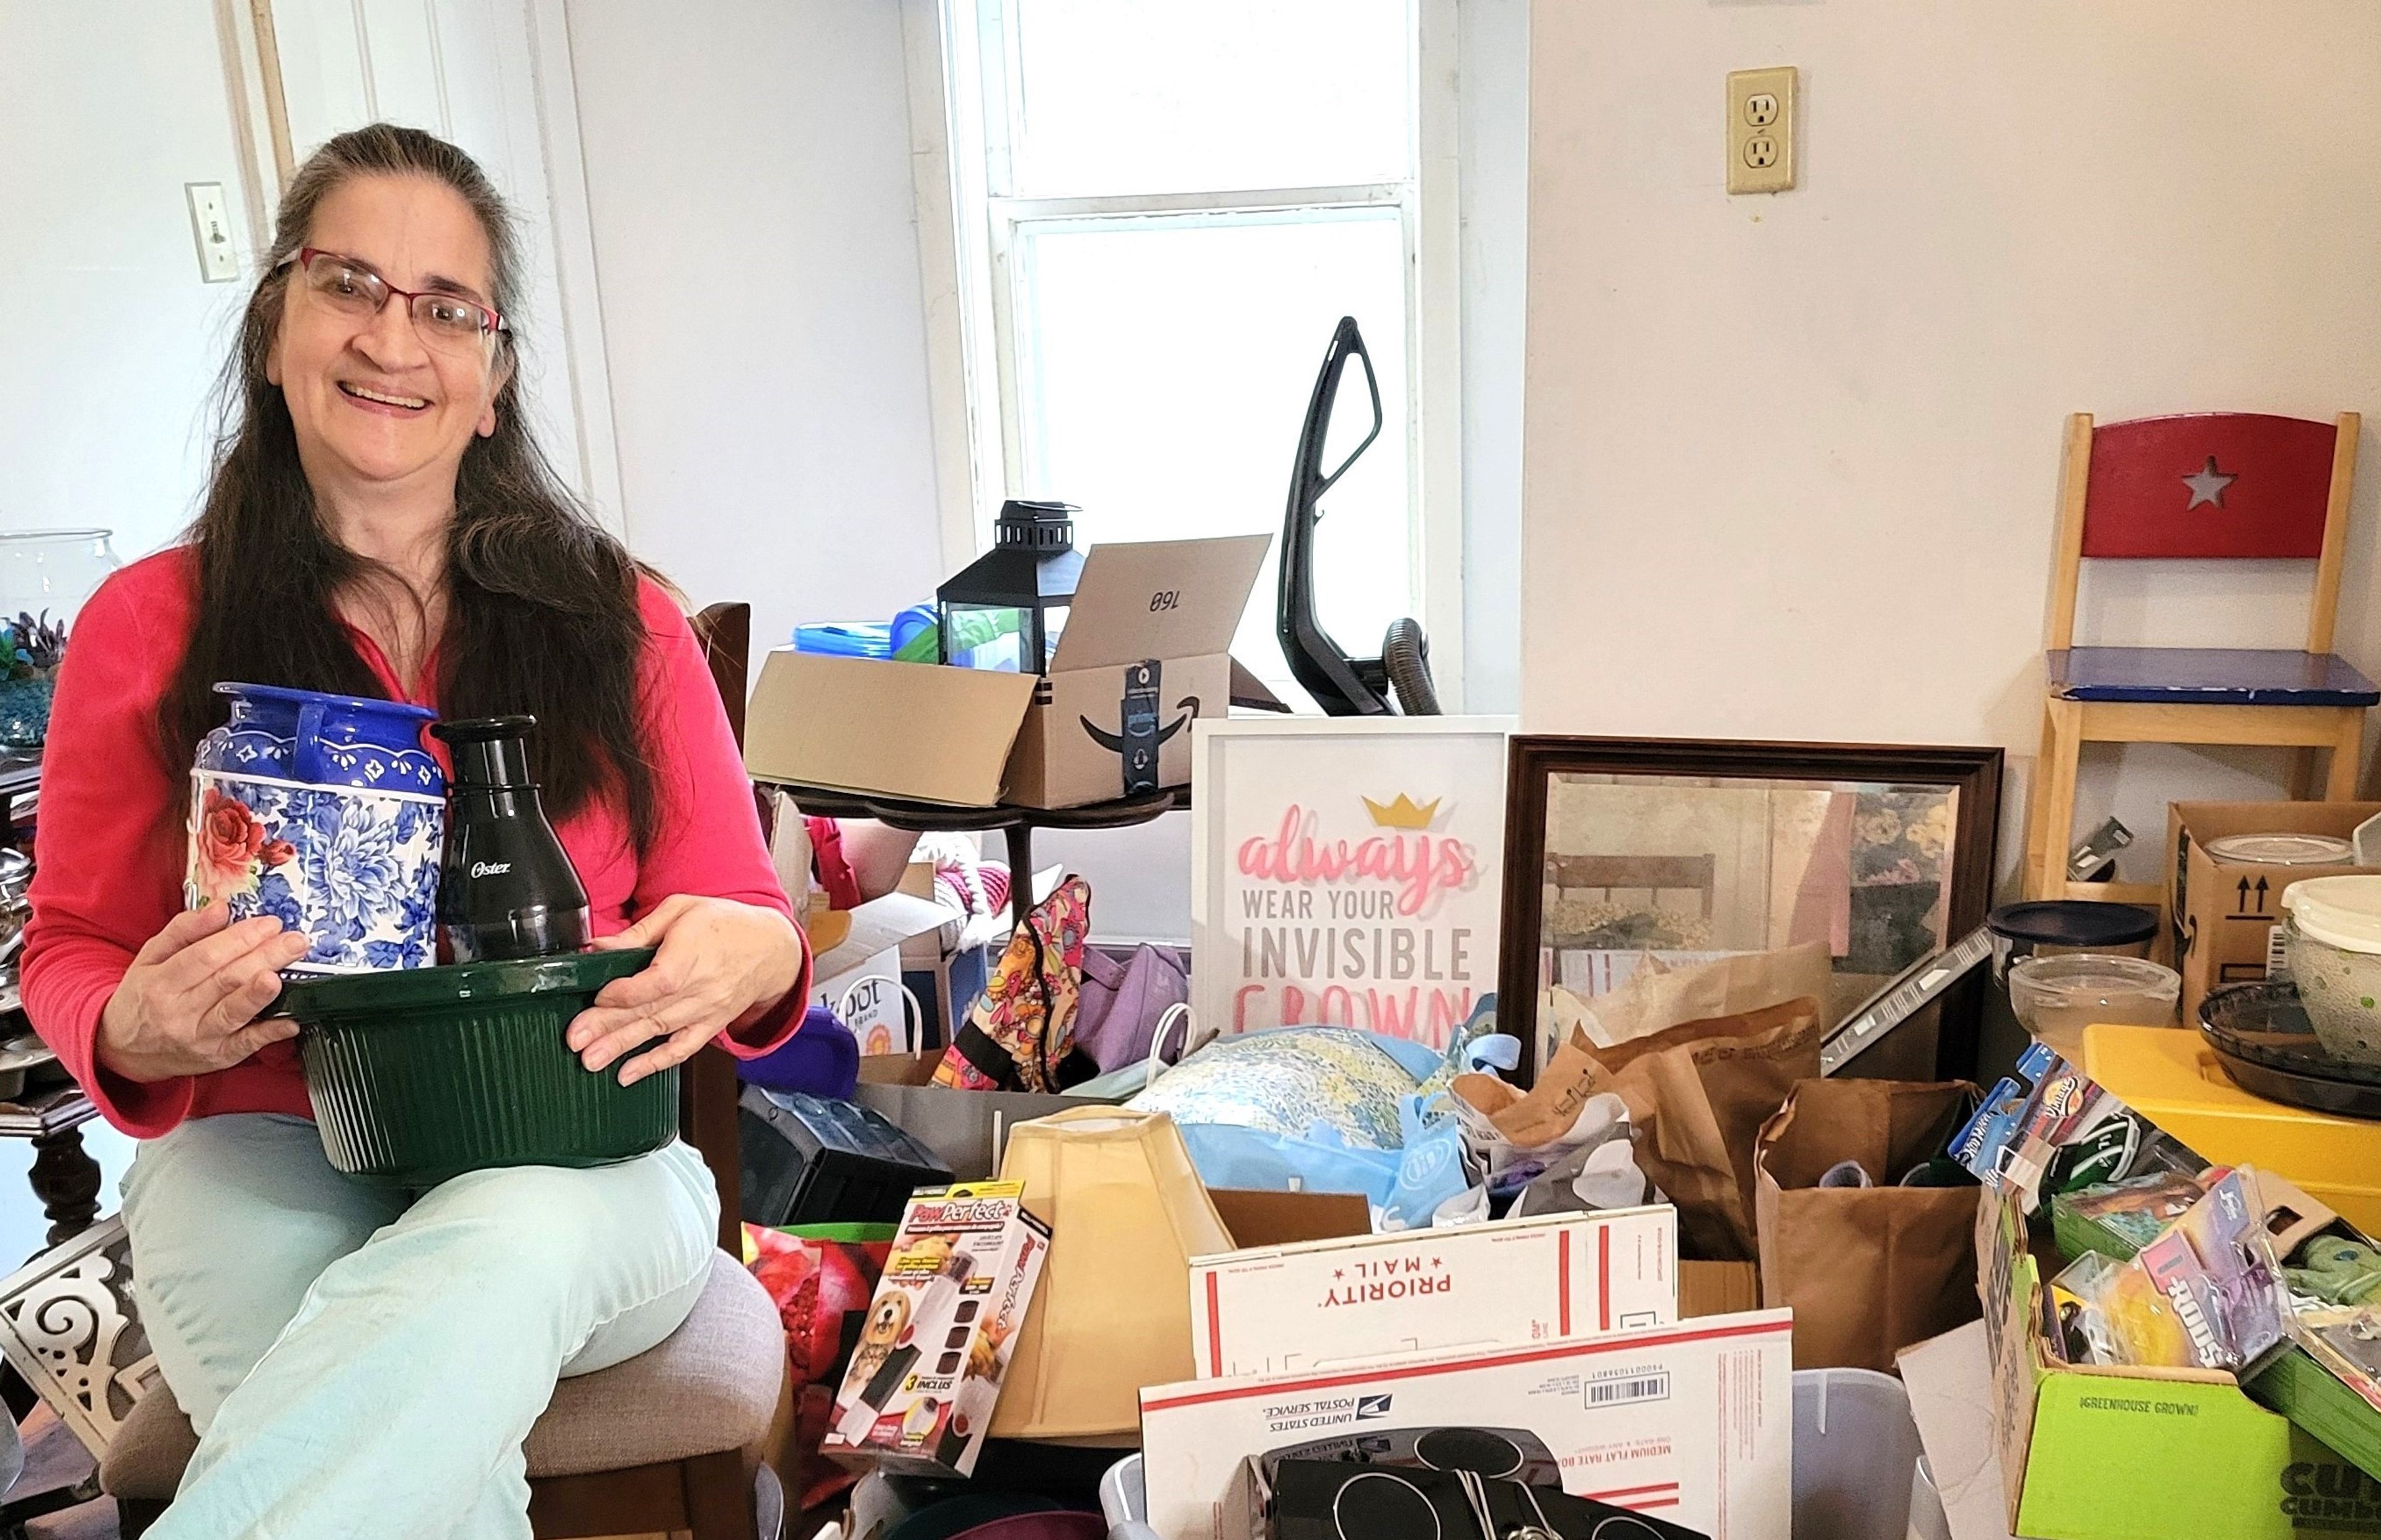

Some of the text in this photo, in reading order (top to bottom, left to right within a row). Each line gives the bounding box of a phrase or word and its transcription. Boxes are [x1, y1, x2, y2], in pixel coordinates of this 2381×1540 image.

[1238, 804, 1475, 916] always
[471, 862, 511, 878] Oster
[1243, 890, 1394, 919] WEAR YOUR
[1243, 927, 1471, 980] INVISIBLE
[1354, 1257, 1421, 1274] MAIL
[1323, 1274, 1452, 1308] PRIORITY
[1313, 1397, 1355, 1413] POSTAL
[1269, 1414, 1352, 1433] UNITED STATES
[1606, 1451, 1628, 1462] FLAT
[1631, 1445, 1671, 1459] MEDIUM
